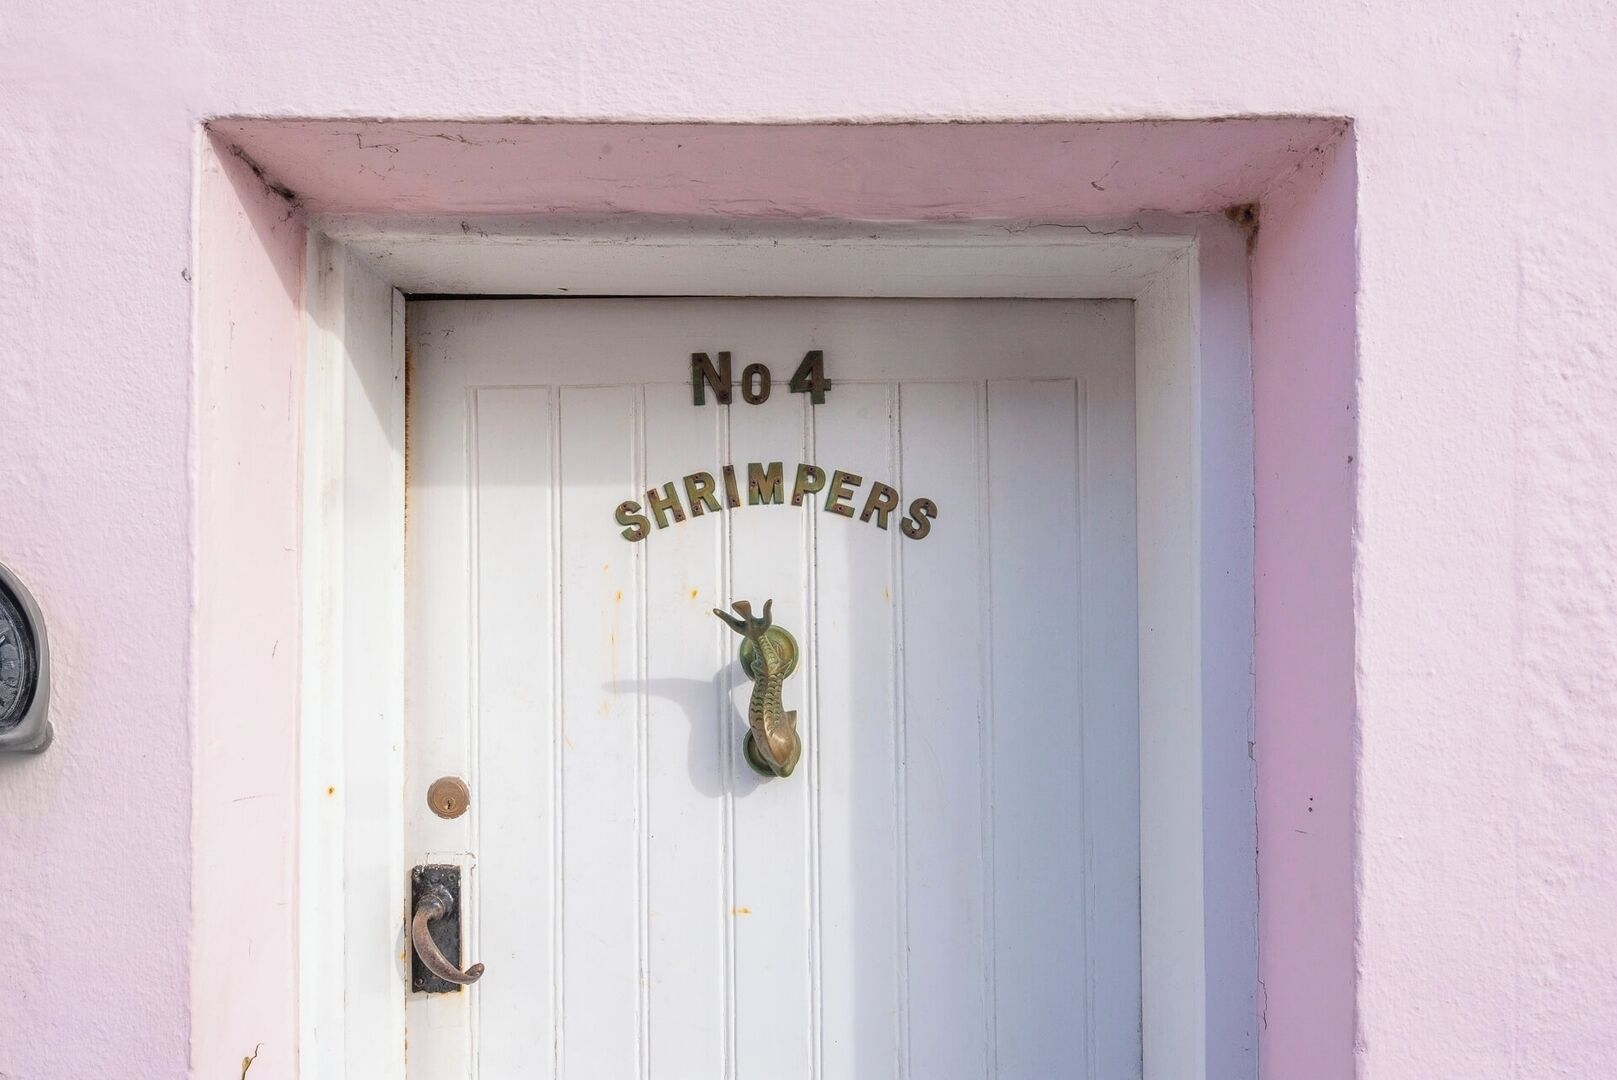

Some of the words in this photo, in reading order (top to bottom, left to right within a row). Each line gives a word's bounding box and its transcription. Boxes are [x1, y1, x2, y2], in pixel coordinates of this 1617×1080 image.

[691, 350, 772, 406] No
[789, 349, 832, 405] 4
[615, 461, 938, 542] SHRIMPERS
